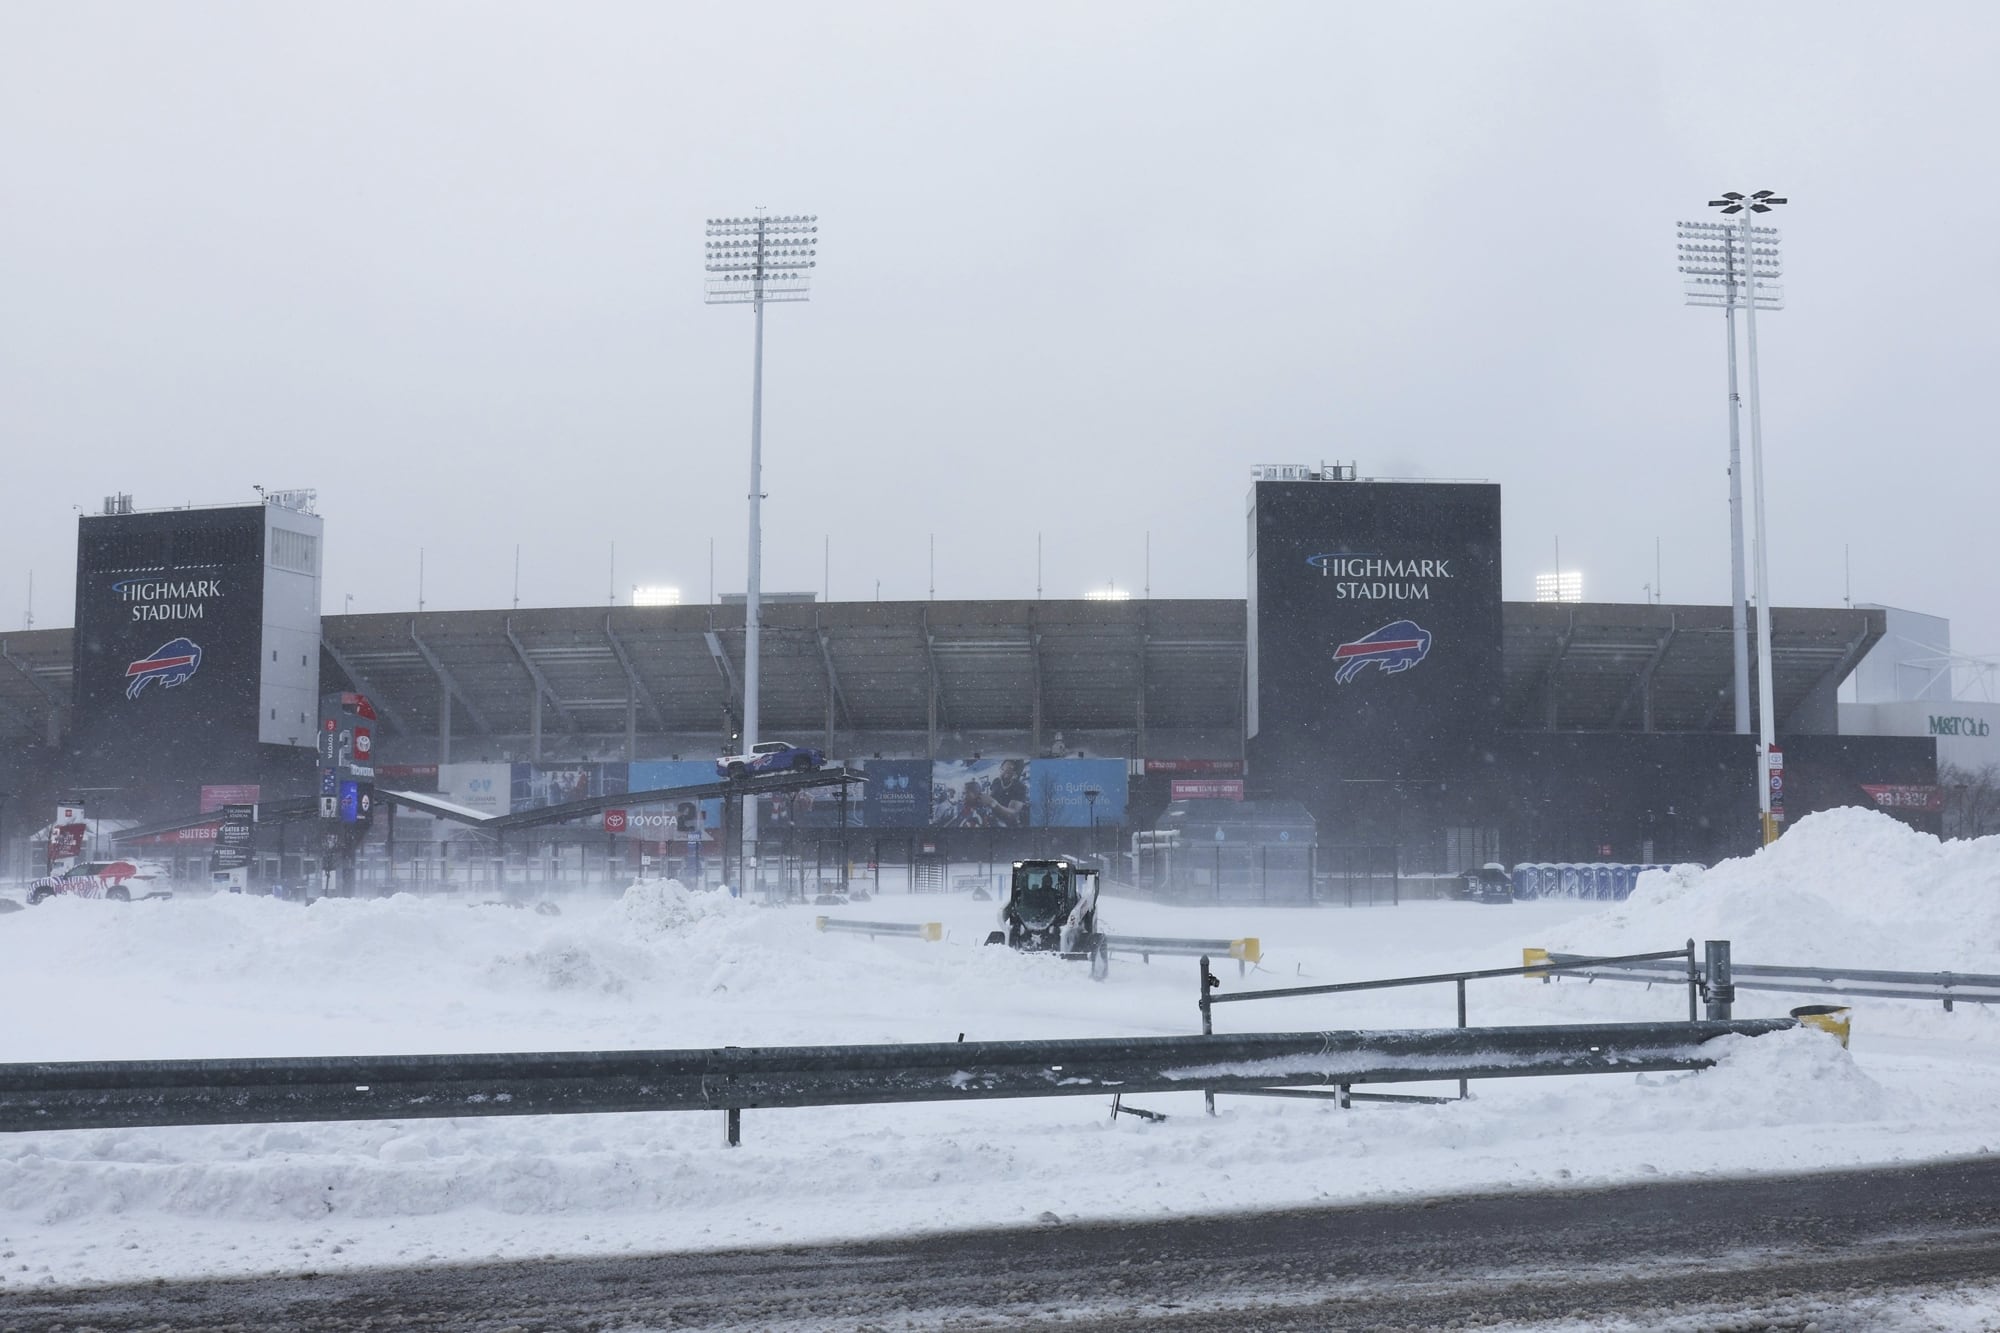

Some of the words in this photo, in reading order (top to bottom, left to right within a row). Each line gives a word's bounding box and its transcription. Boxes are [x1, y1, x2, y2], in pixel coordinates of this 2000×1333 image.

[1335, 581, 1430, 601] STADIUM
[131, 602, 204, 622] STADIUM
[1928, 715, 1961, 735] M&T
[1962, 716, 1990, 737] Club
[326, 733, 334, 760] TOYOTA
[626, 815, 678, 827] TOYOTA
[179, 828, 210, 839] SUITES
